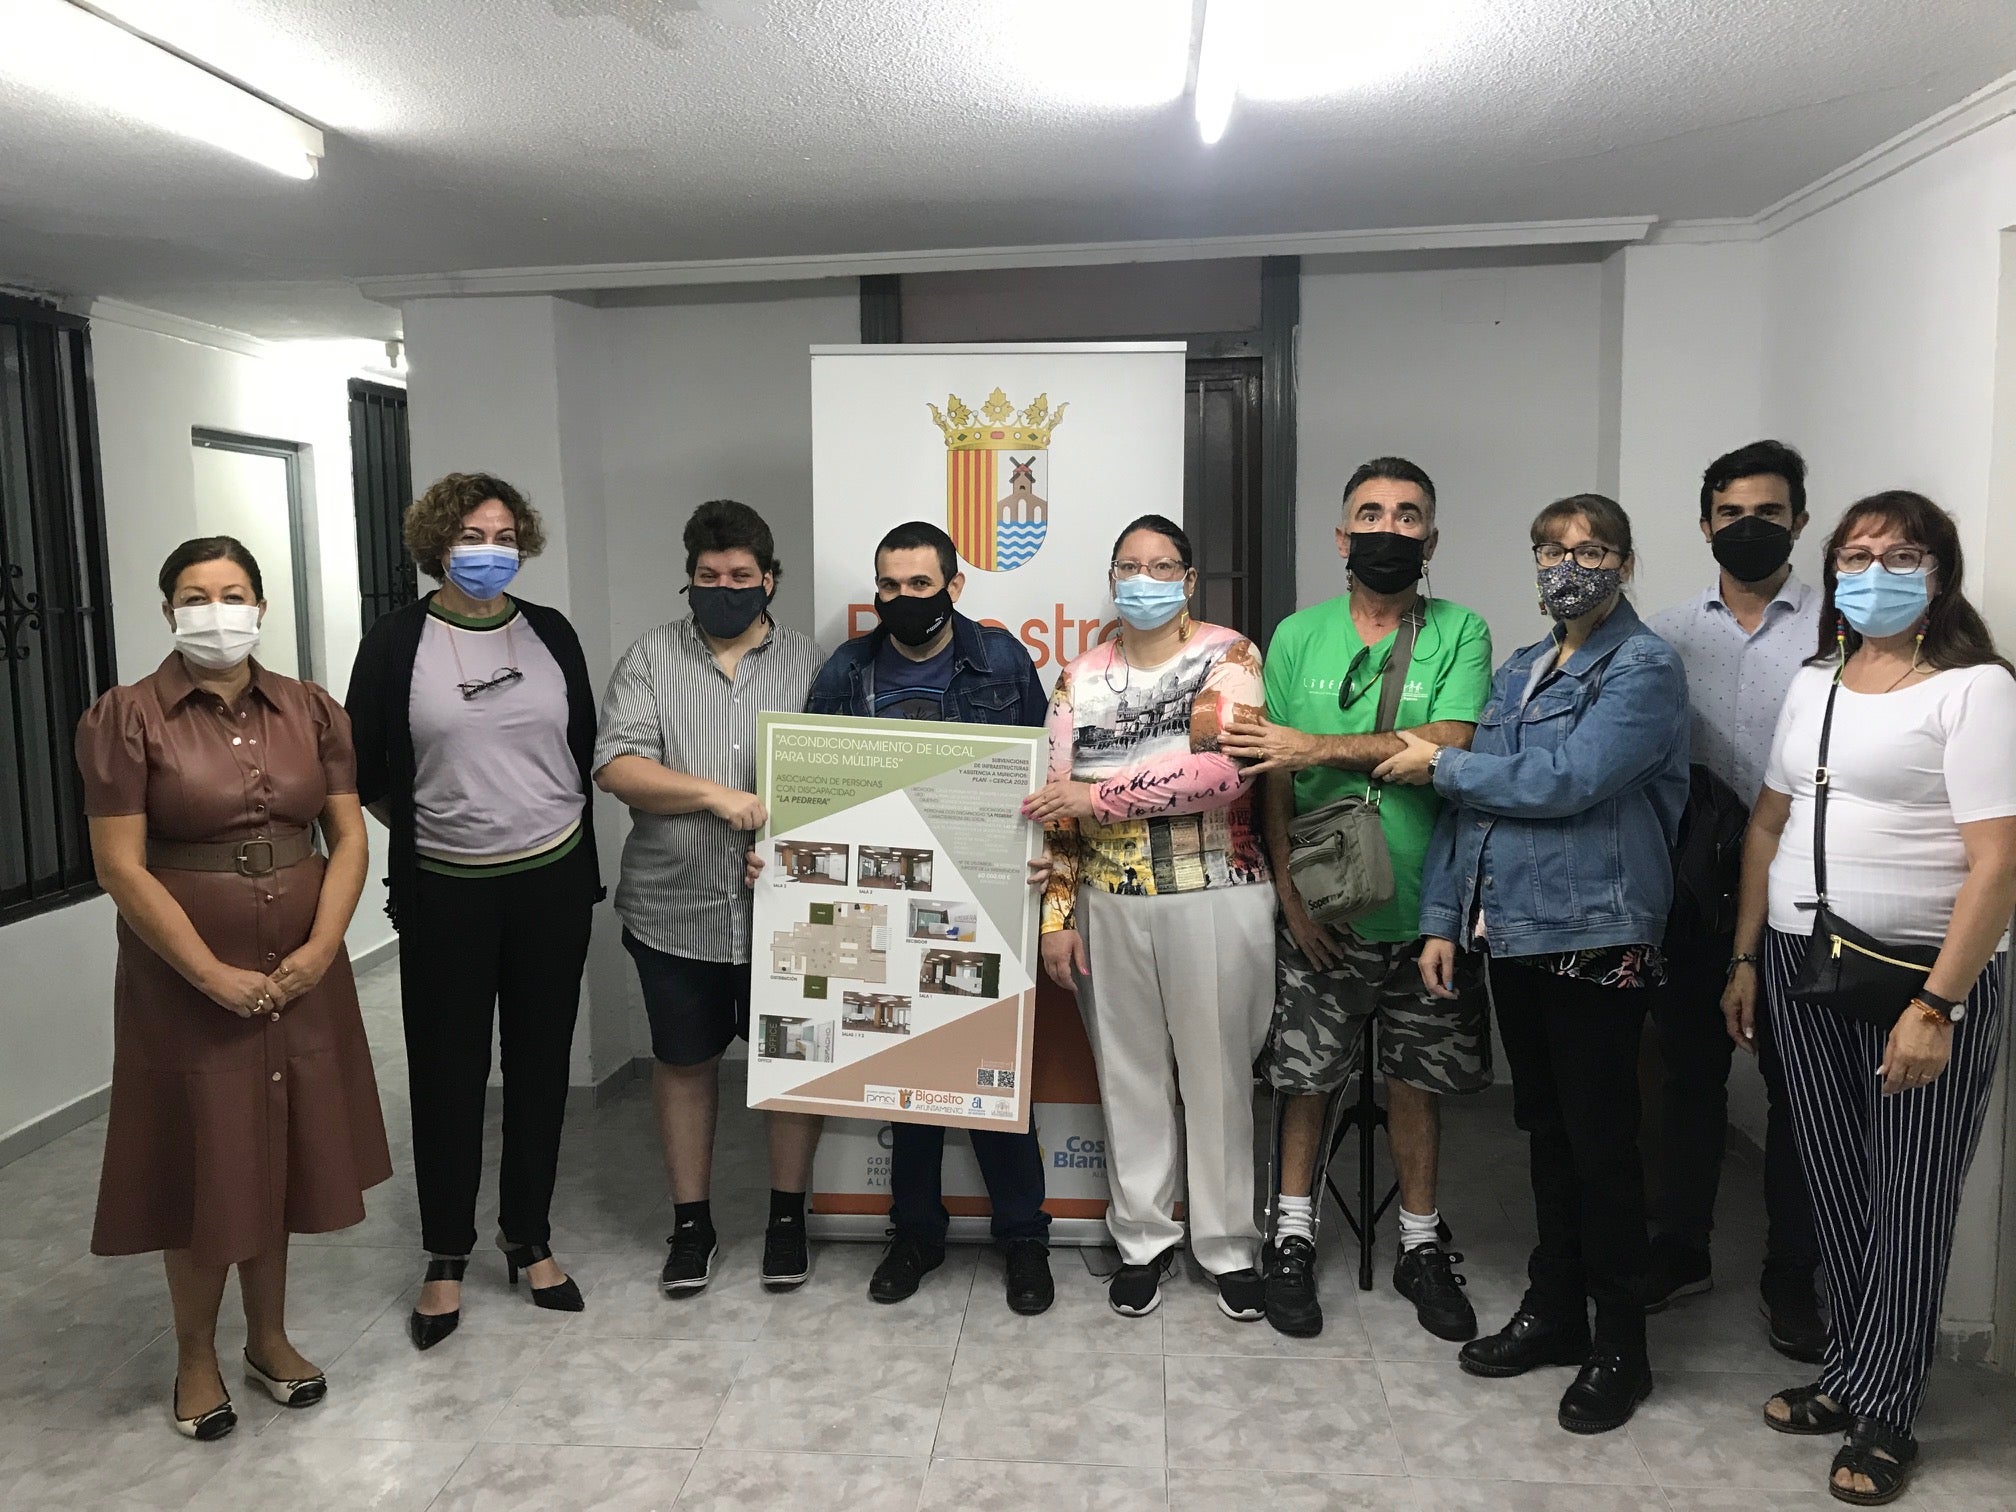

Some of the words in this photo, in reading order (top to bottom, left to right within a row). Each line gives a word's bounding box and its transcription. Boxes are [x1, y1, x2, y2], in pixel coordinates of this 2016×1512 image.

[775, 750, 805, 763] PARA
[808, 752, 839, 765] USOS
[916, 742, 932, 755] DE
[936, 744, 976, 758] LOCAL
[776, 774, 828, 785] ASOCIACIÓN
[829, 777, 840, 786] DE
[842, 778, 883, 789] PERSONAS
[776, 784, 796, 793] CON
[797, 785, 856, 797] DISCAPACIDAD
[768, 1023, 778, 1054] OFFICE
[915, 1090, 964, 1105] Bigastro
[915, 1104, 964, 1115] AYUNTAMIENTO
[1053, 1151, 1107, 1169] Blan
[867, 1178, 892, 1186] ALI
